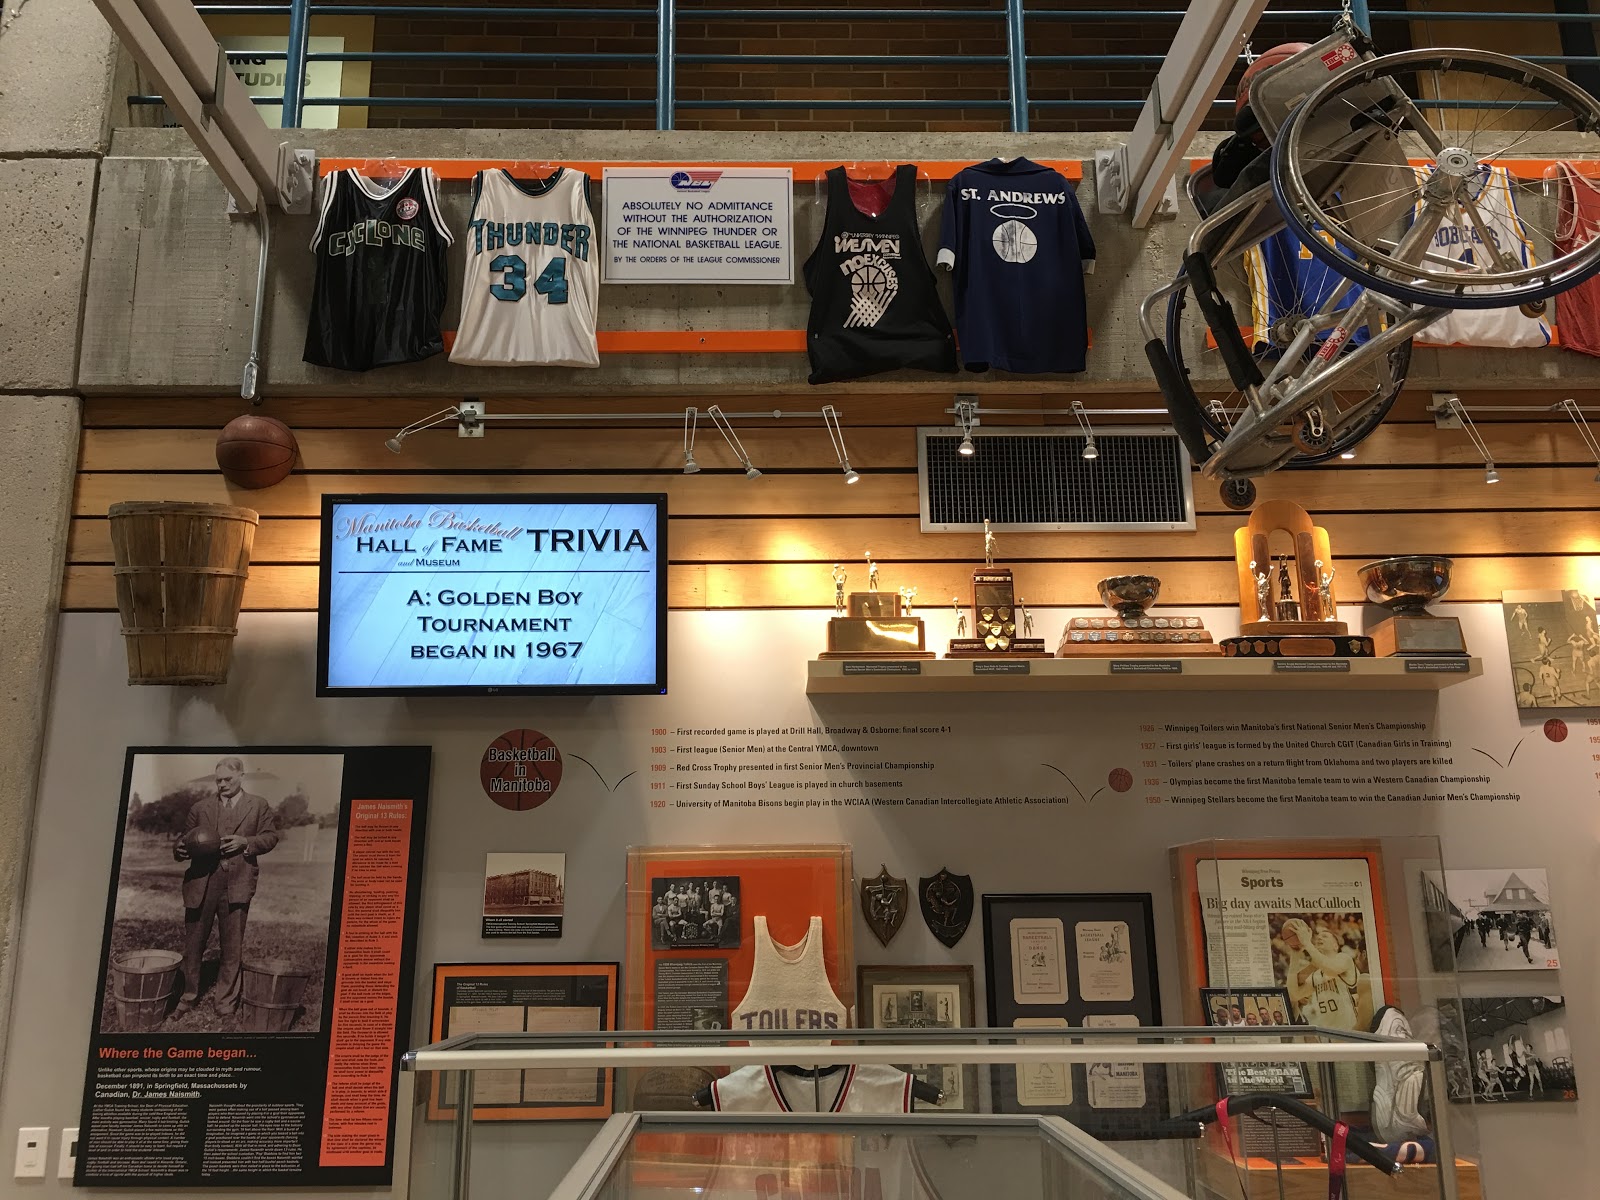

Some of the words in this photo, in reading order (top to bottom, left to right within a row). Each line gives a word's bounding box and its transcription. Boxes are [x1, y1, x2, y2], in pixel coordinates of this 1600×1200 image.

[961, 188, 981, 200] ST.
[987, 190, 1066, 204] ANDREWS
[622, 201, 681, 210] ABSOLUTELY
[686, 201, 703, 210] NO
[707, 201, 772, 210] ADMITTANCE
[622, 214, 666, 222] WITHOUT
[671, 214, 687, 222] THE
[692, 214, 772, 223] AUTHORIZATION
[328, 219, 426, 256] CYCLONE
[616, 226, 631, 235] OF
[636, 226, 652, 235] THE
[657, 226, 707, 235] WINNIPEG
[712, 227, 757, 236] THUNDER
[761, 227, 777, 236] OR
[468, 218, 592, 262] THUNDER
[612, 239, 628, 248] THE
[632, 239, 681, 248] NATIONAL
[685, 239, 740, 248] BASKETBALL
[744, 240, 782, 249] LEAGUE.
[490, 254, 568, 304] 34
[864, 254, 898, 290] EXCUSES
[336, 512, 422, 540] Manitoba
[428, 510, 524, 540] Basketball
[356, 536, 416, 552] HALL
[422, 540, 438, 557] of
[442, 536, 503, 552] FAME
[526, 528, 649, 552] TRIVIA
[398, 559, 415, 567] and
[416, 558, 460, 567] MUSEUM
[406, 590, 431, 606] A:
[438, 590, 531, 606] GOLDEN
[538, 590, 583, 606] BOY
[417, 616, 572, 632] TOURNAMENT
[410, 644, 487, 659] BEGAN
[494, 644, 516, 659] IN
[526, 642, 583, 659] 1967
[676, 727, 693, 736] First
[693, 727, 726, 736] recorded
[756, 727, 780, 736] played
[789, 727, 805, 735] Drill
[806, 726, 824, 735] Hall,
[824, 726, 861, 735] Broadway
[1164, 724, 1198, 733] Winnipeg
[1199, 723, 1224, 731] Toilers
[1328, 722, 1352, 730] Senior
[1375, 721, 1426, 731] Championship
[488, 746, 556, 762] Basketball
[676, 745, 692, 753] First
[693, 745, 718, 755] league
[746, 745, 765, 753] Men)
[788, 744, 814, 752] Central
[815, 744, 840, 752] YMCA,
[514, 762, 527, 777] in
[676, 763, 690, 771] Red
[691, 763, 712, 771] Cross
[712, 763, 737, 772] Trophy
[738, 763, 774, 772] presented
[775, 762, 782, 770] in
[783, 762, 798, 770] first
[799, 762, 822, 770] Senior
[846, 761, 882, 769] Provincial
[884, 761, 934, 770] Championship
[1167, 759, 1193, 767] Toilers'
[1194, 759, 1215, 768] plane
[1285, 758, 1304, 767] flight
[1391, 757, 1418, 766] players
[490, 777, 552, 792] Manitoba
[356, 812, 379, 820] Original
[1241, 876, 1284, 890] Sports
[1206, 897, 1228, 911] Big
[1231, 897, 1251, 912] day
[1254, 897, 1292, 909] awaits
[1295, 896, 1360, 909] MacCulloch
[1319, 999, 1338, 1014] 50
[740, 1008, 838, 1029] TOILERS
[99, 1047, 139, 1058] Where
[143, 1048, 163, 1058] the
[167, 1047, 203, 1058] Game
[208, 1047, 257, 1060] began...
[95, 1091, 131, 1099] Canadian,
[1564, 1090, 1575, 1098] 26
